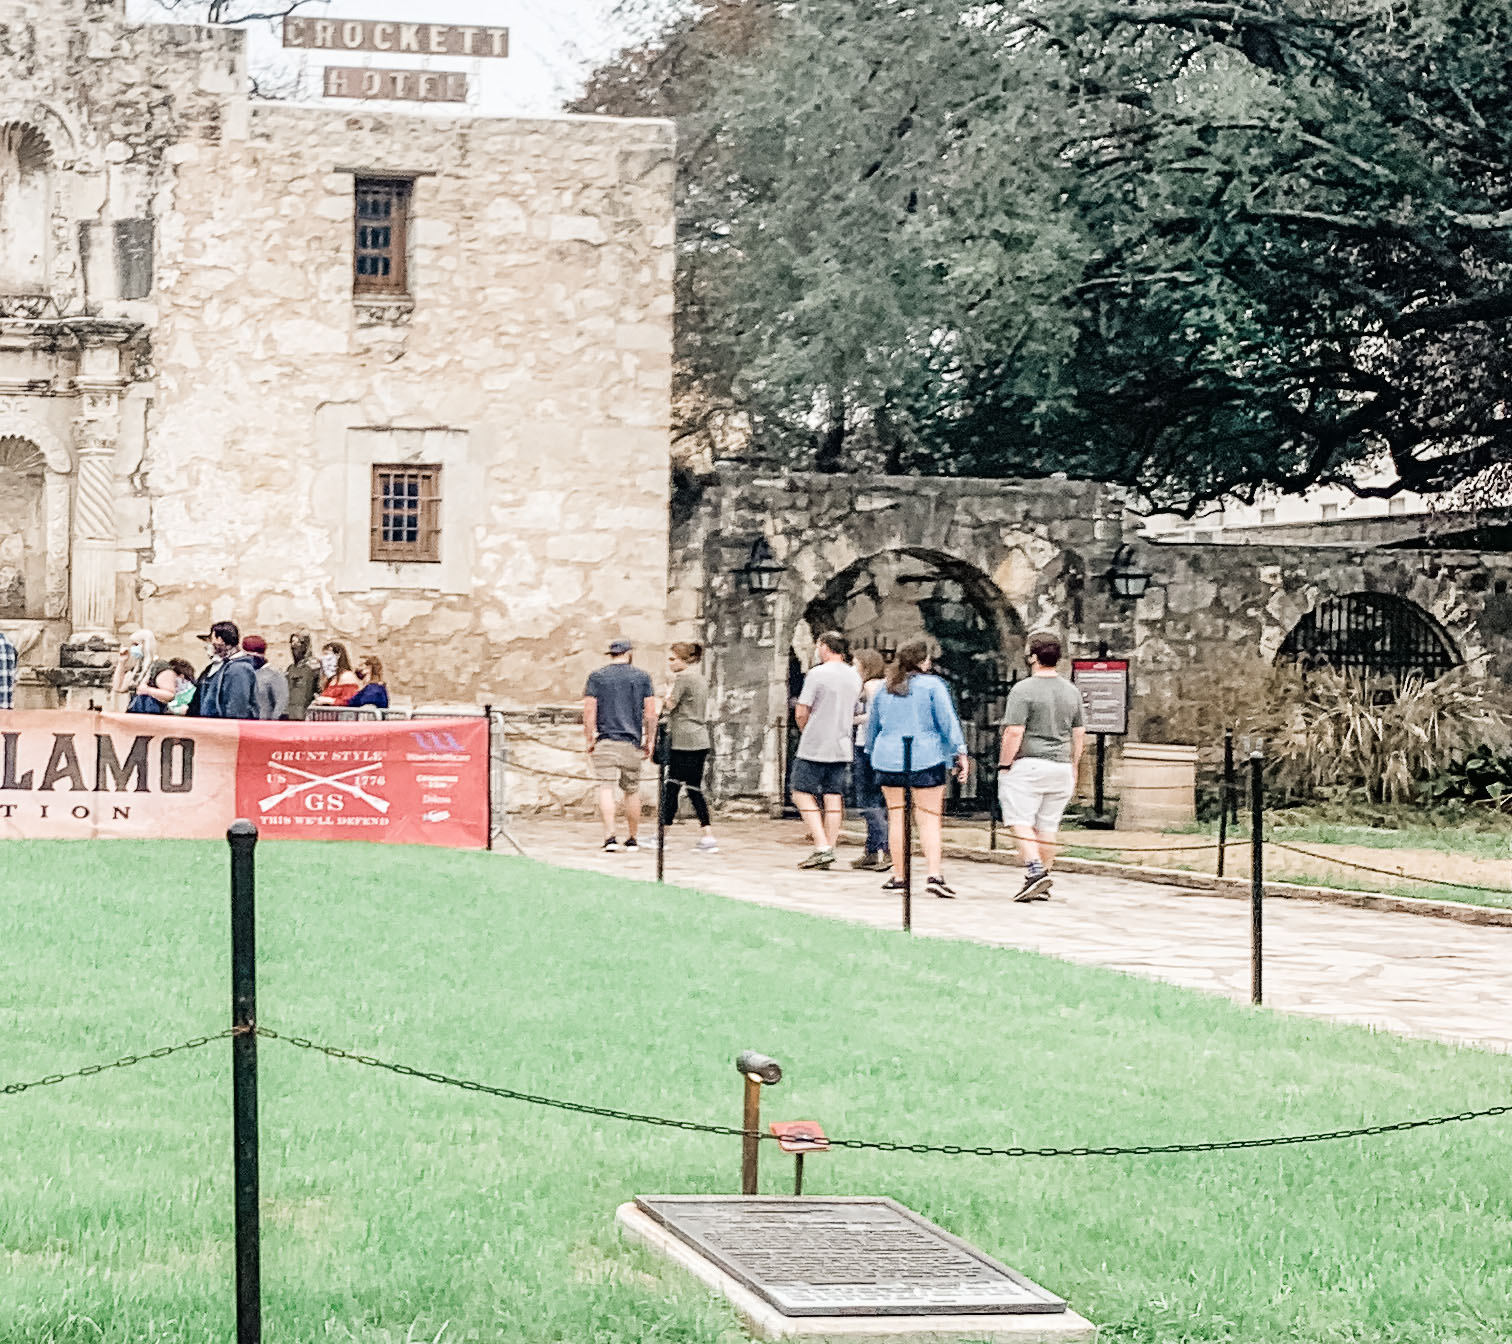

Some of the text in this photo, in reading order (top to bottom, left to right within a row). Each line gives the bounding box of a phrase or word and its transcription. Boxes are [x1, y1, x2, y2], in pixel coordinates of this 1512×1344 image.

[287, 17, 508, 56] CROCKETT
[271, 751, 384, 761] GRUNT STYLE
[354, 775, 386, 787] 1776
[304, 793, 345, 812] GS
[260, 815, 292, 825] THIS
[337, 816, 390, 826] DEFEND
